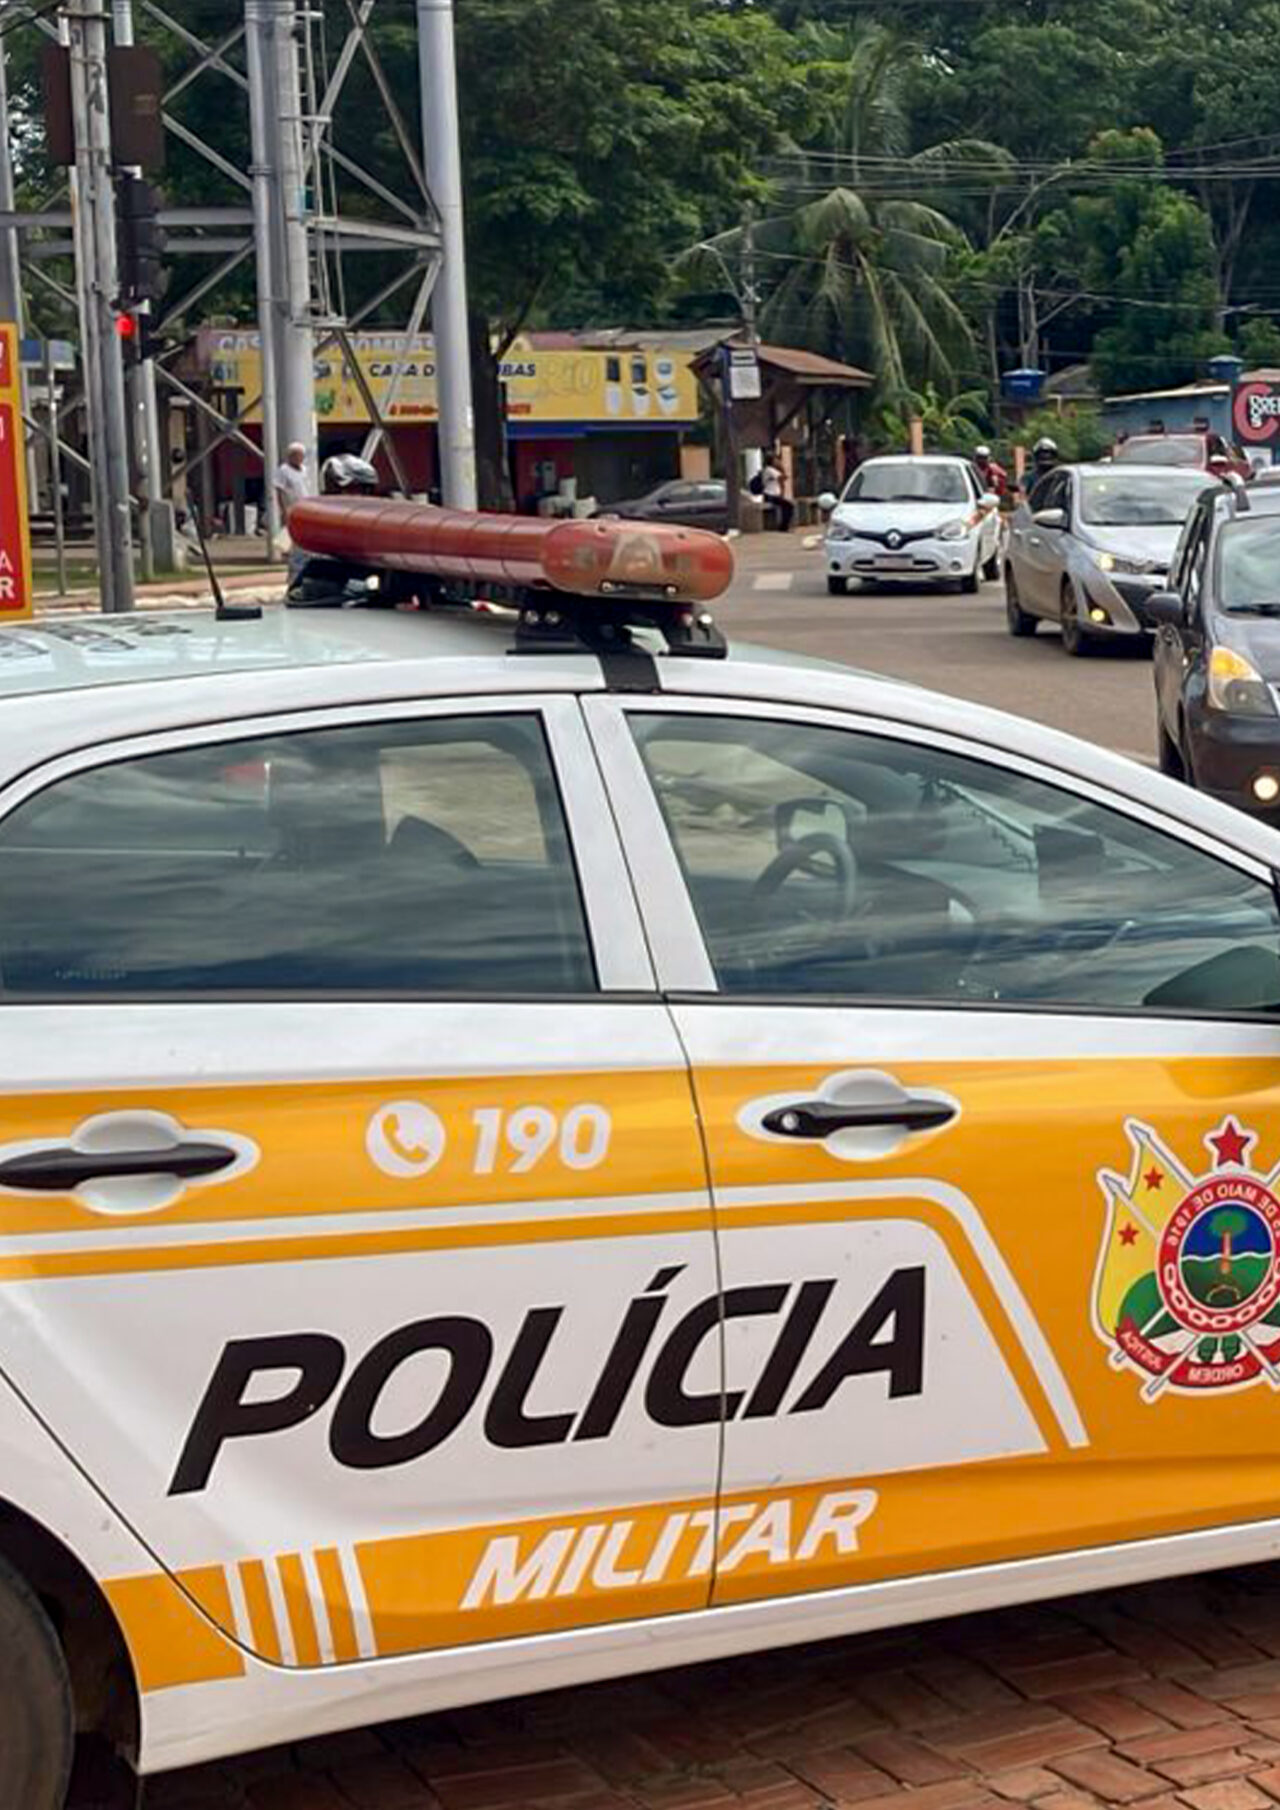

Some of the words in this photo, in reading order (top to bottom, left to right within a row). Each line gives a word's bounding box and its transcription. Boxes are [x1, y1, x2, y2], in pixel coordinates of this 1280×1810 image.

[470, 1103, 612, 1176] 190
[167, 1264, 926, 1497] POLÍCIA
[460, 1488, 879, 1611] MILITAR
